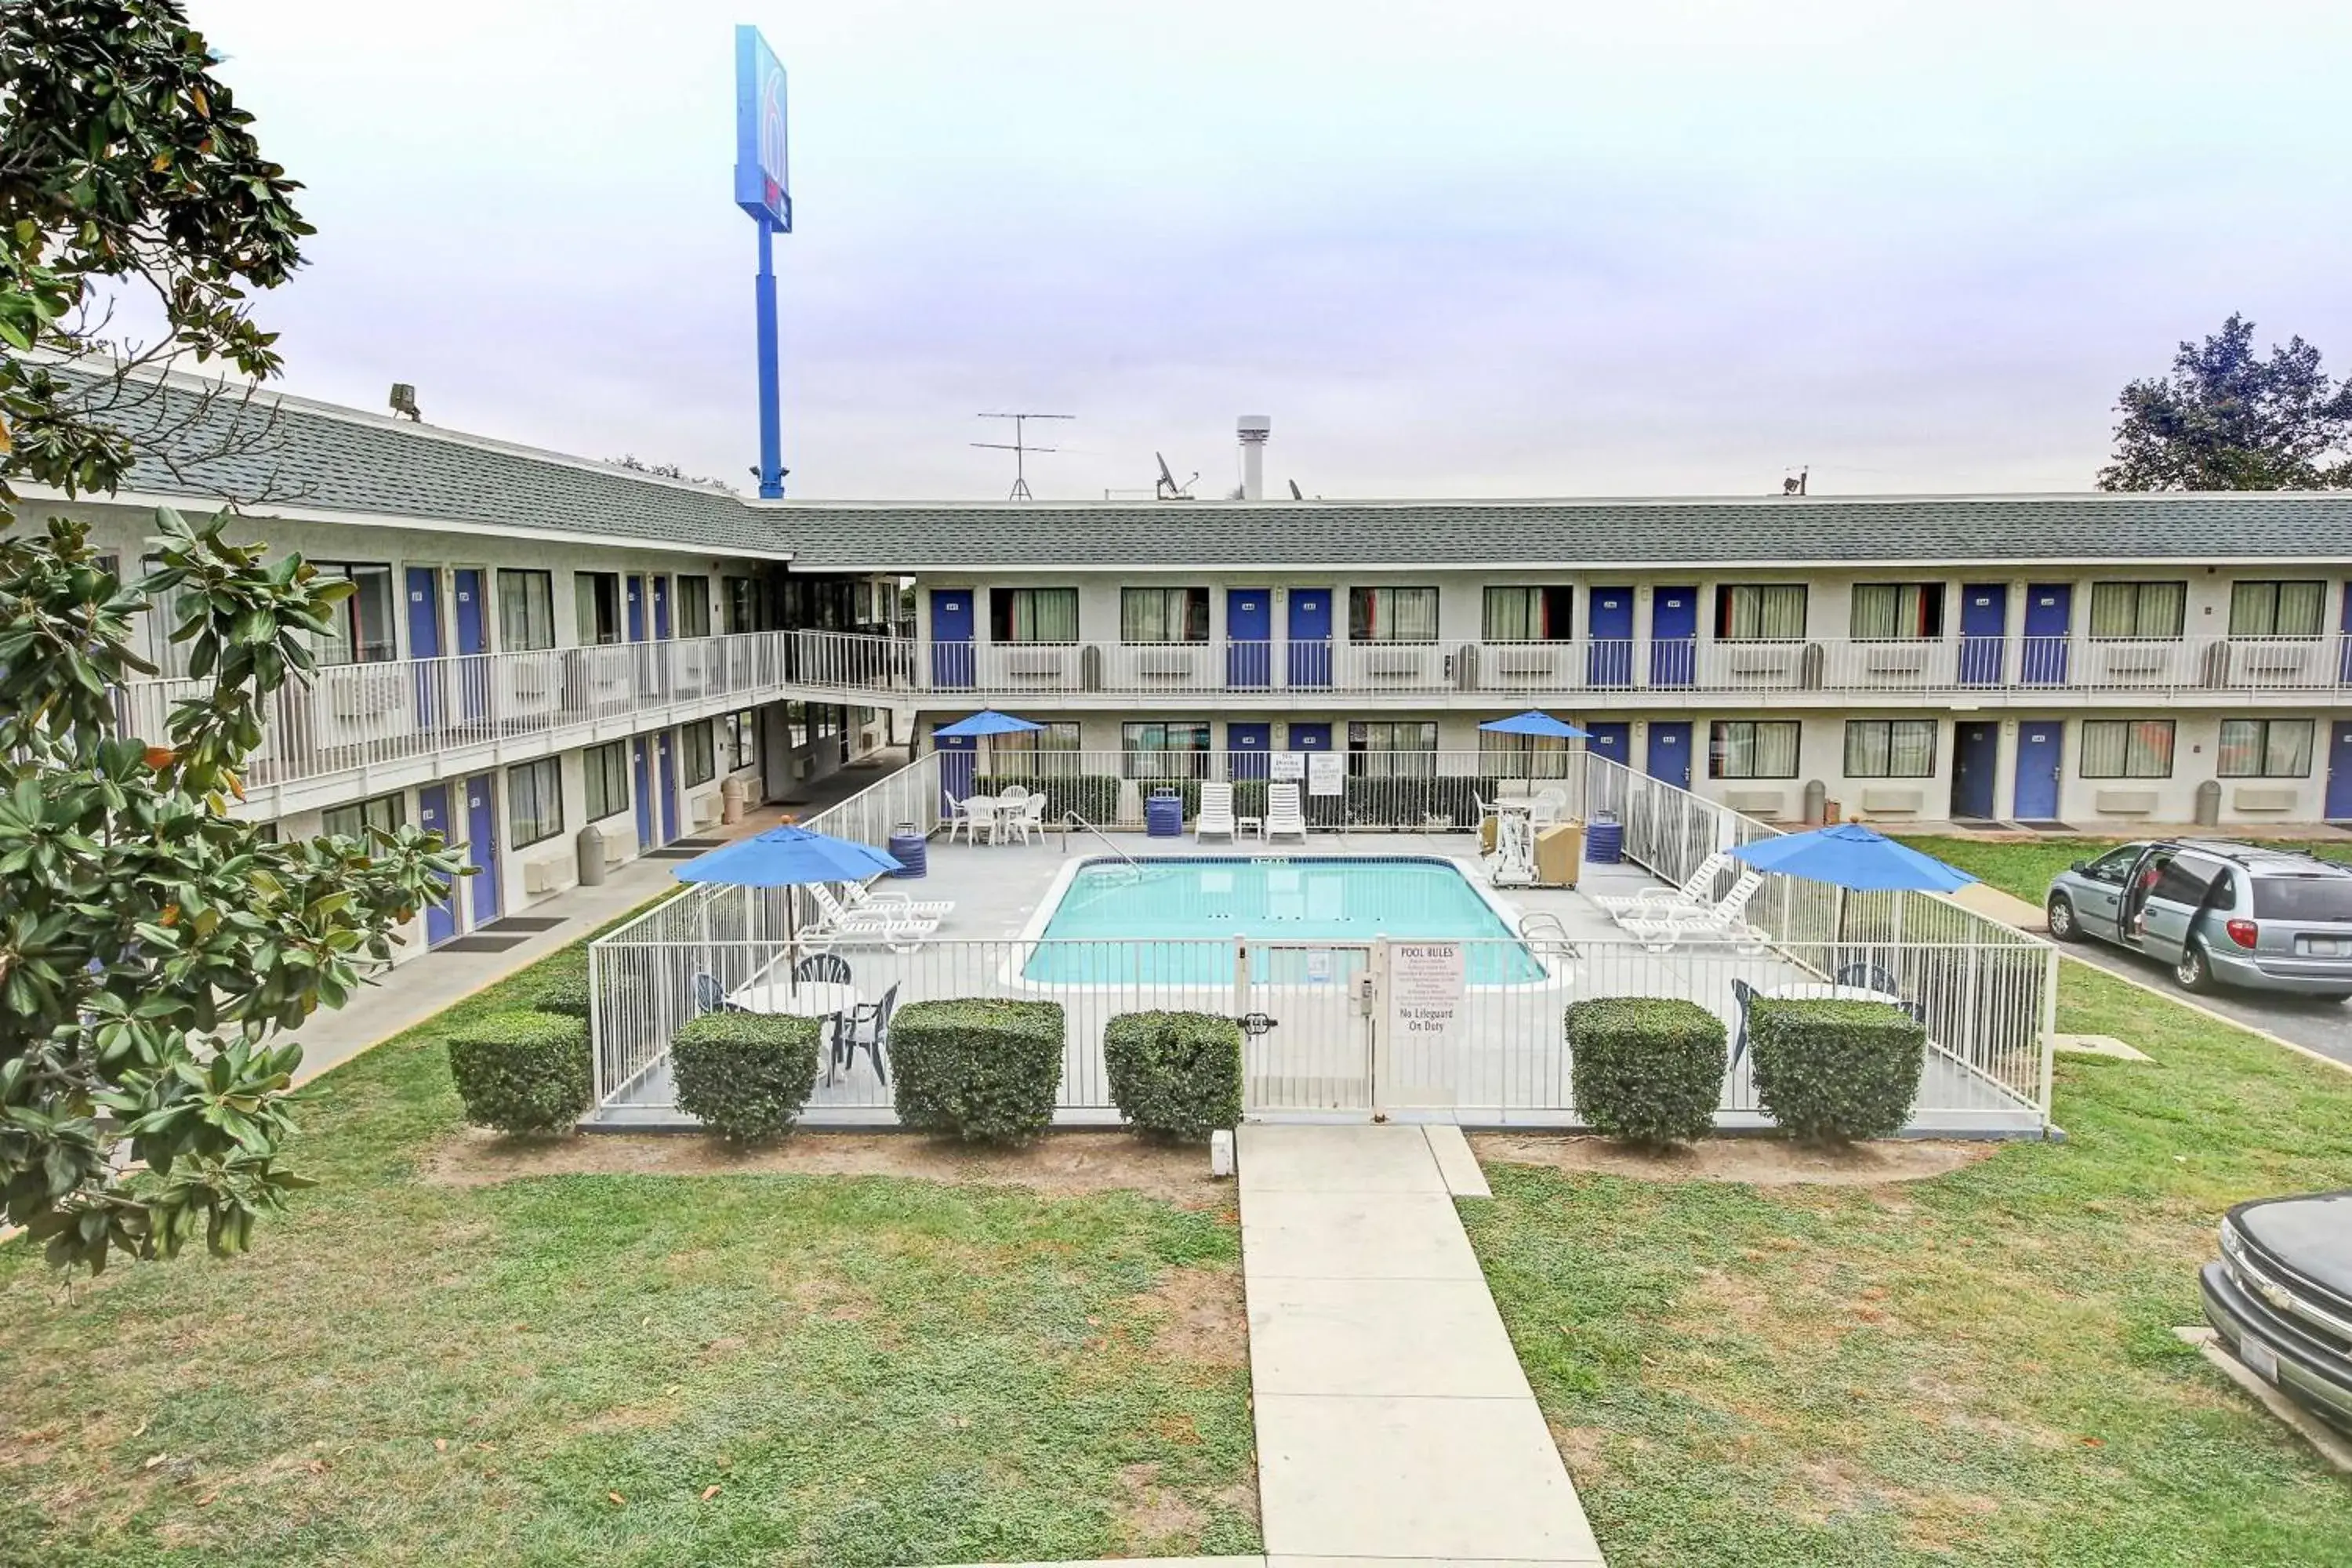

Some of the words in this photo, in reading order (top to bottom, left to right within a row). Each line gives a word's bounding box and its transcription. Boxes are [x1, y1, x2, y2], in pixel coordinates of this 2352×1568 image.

[1401, 947, 1424, 957] POOL
[1426, 946, 1454, 957] RULES
[1399, 1007, 1412, 1018] No
[1415, 1007, 1454, 1021] Lifeguard
[1409, 1021, 1421, 1032] On
[1425, 1020, 1443, 1033] Duty
